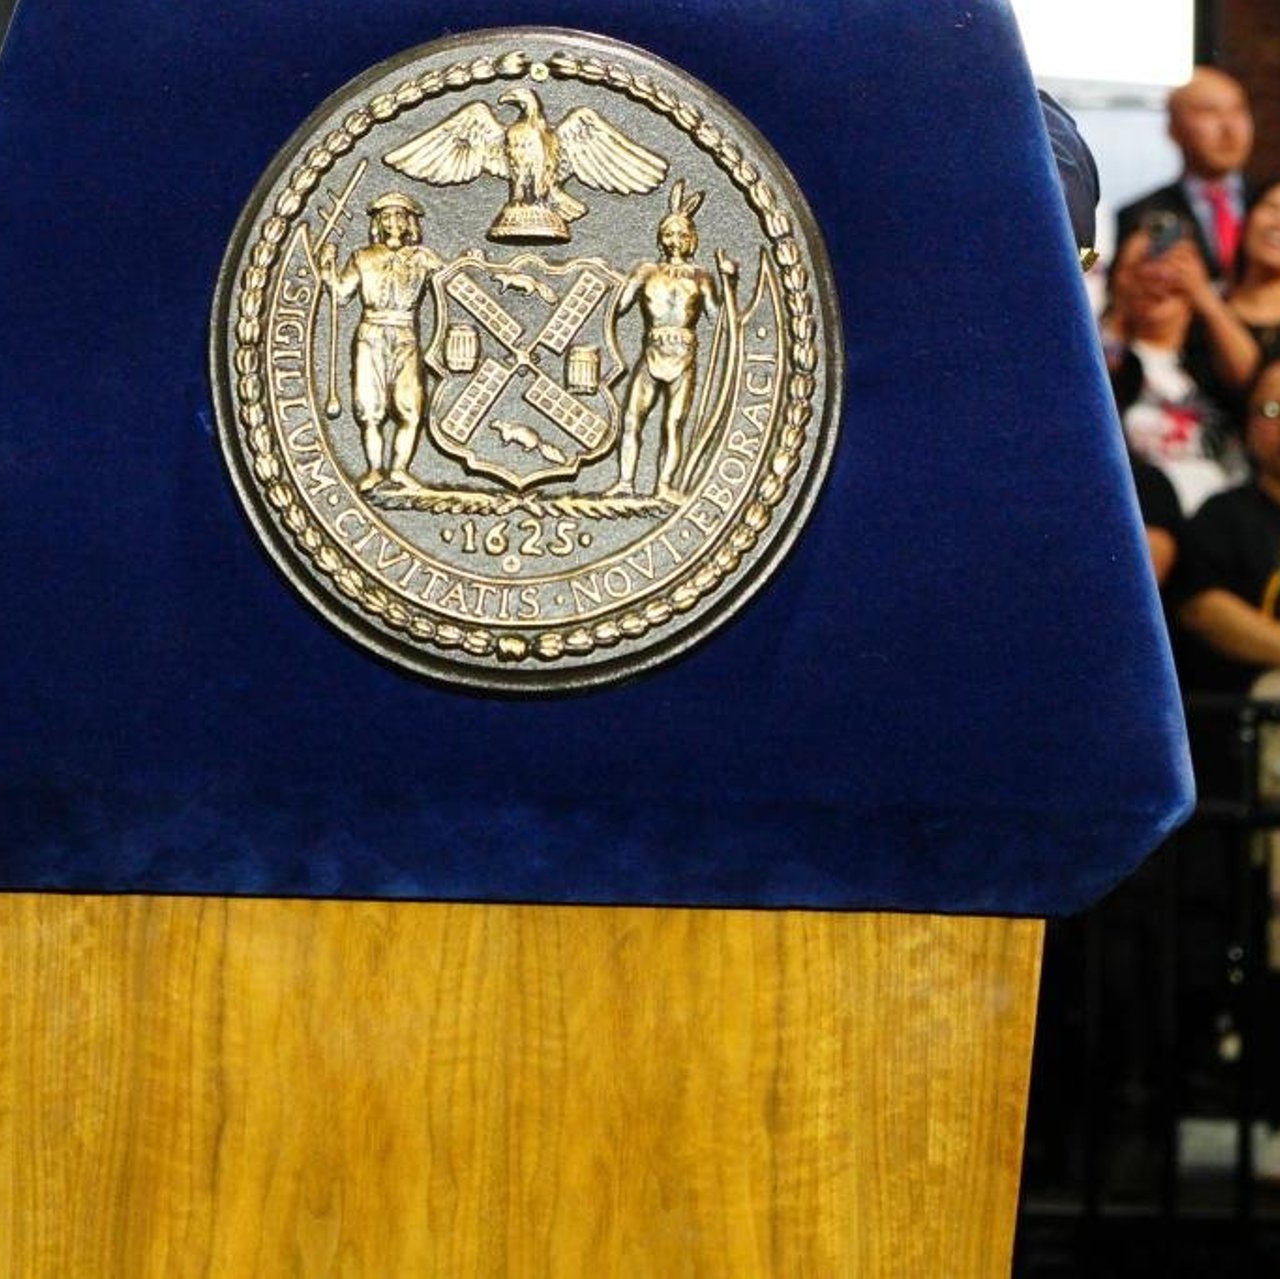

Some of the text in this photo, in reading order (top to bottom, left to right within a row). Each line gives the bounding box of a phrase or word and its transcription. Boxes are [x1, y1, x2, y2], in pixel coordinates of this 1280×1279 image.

[269, 280, 777, 619] SIGILLUM CIVITATIS NOVI EBORACI
[461, 518, 576, 557] 1625
